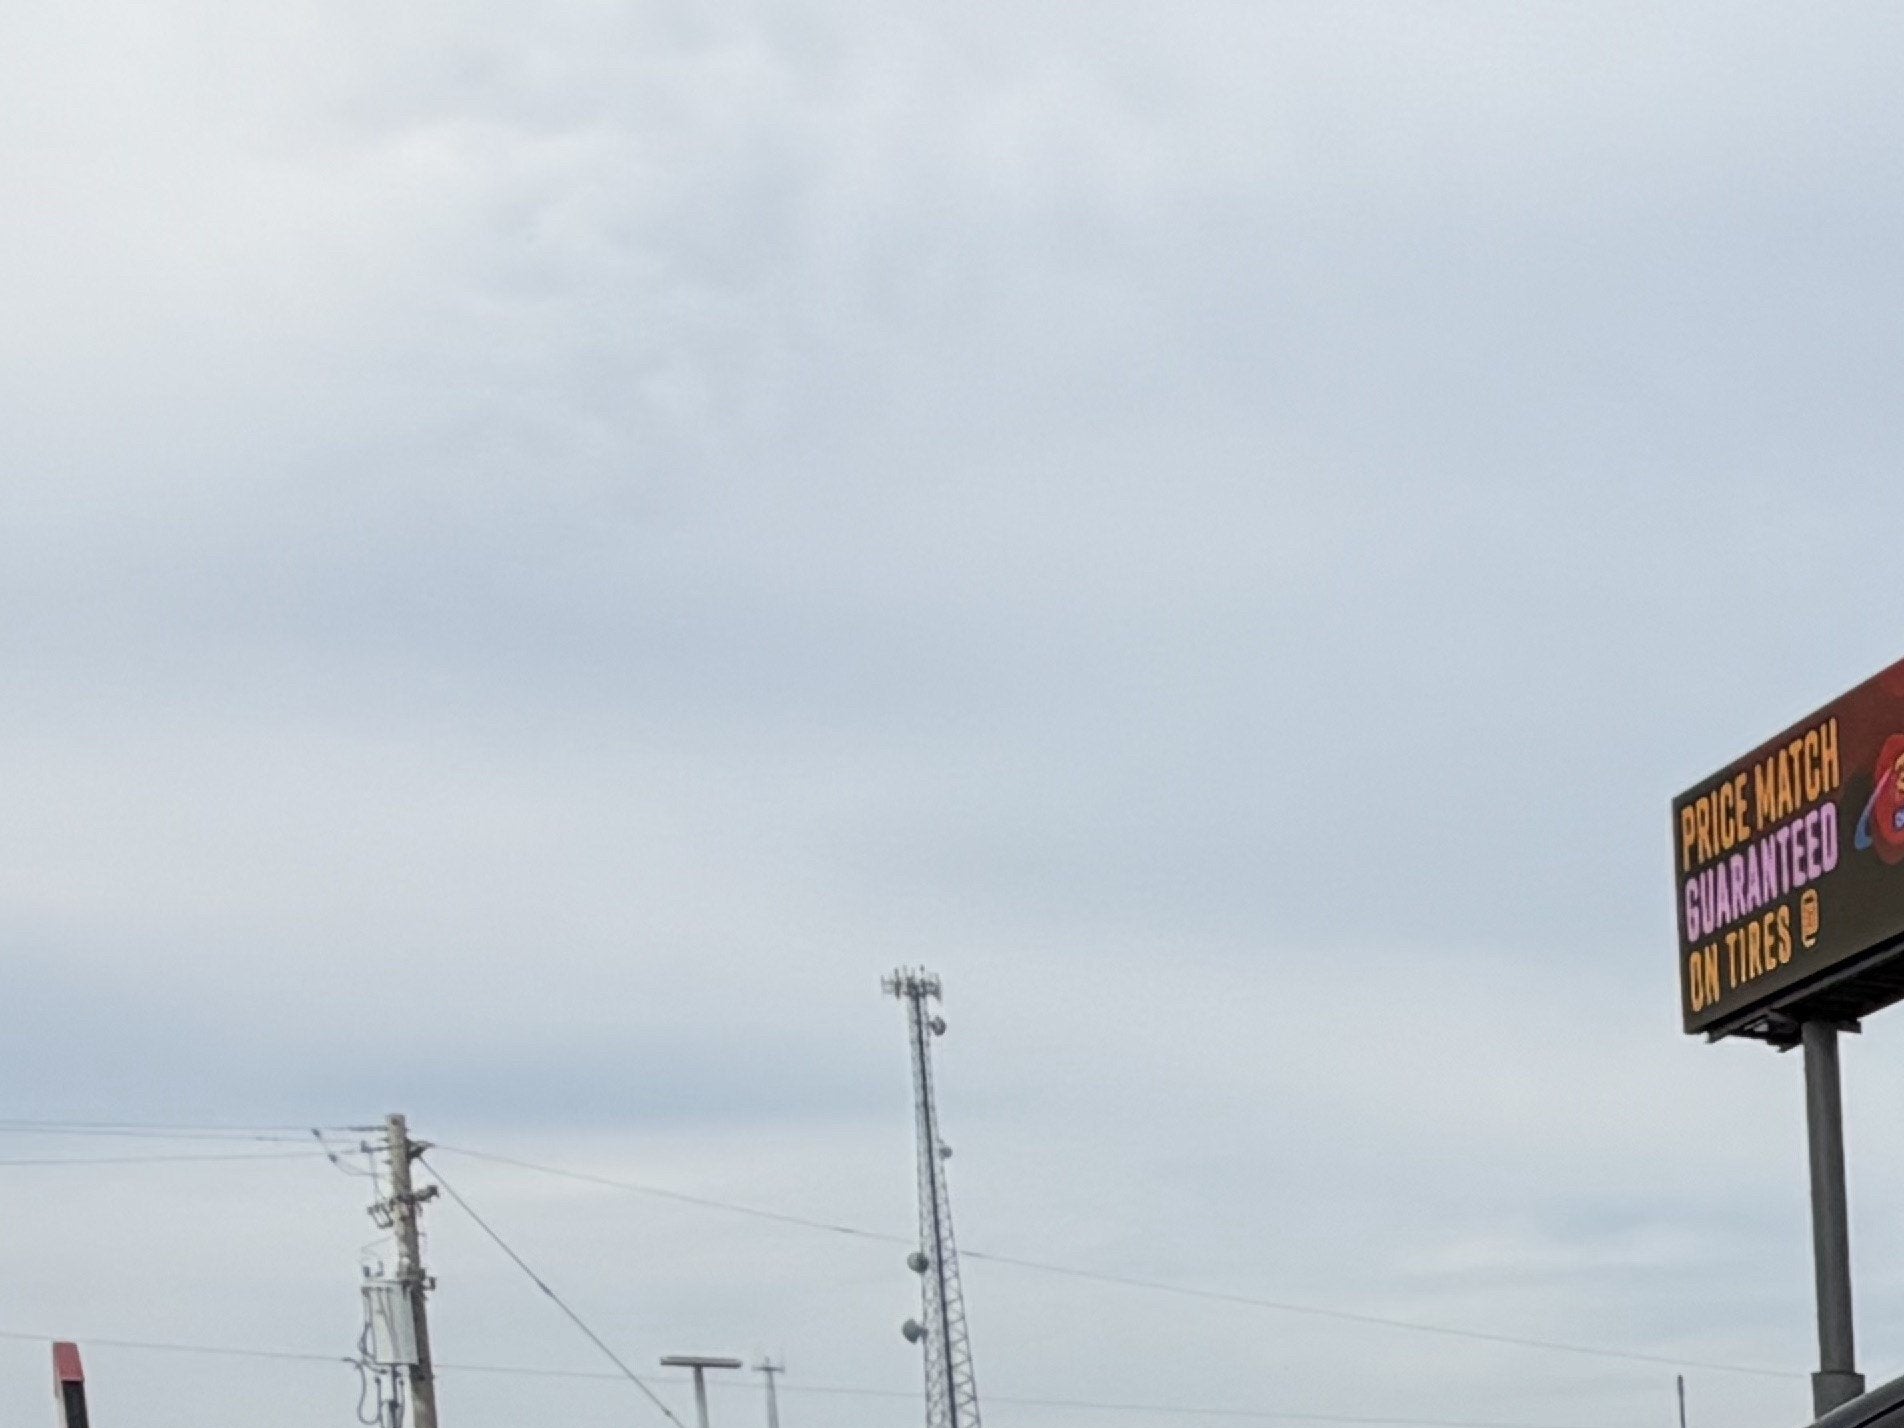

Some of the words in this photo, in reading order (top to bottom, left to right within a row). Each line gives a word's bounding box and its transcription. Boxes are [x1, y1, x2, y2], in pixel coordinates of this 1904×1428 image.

[1681, 771, 1750, 871] PRICE
[1754, 717, 1840, 832] MATCH
[1684, 801, 1838, 943] GUARANTEED
[1689, 937, 1720, 1013] ON
[1725, 905, 1792, 988] TIRES
